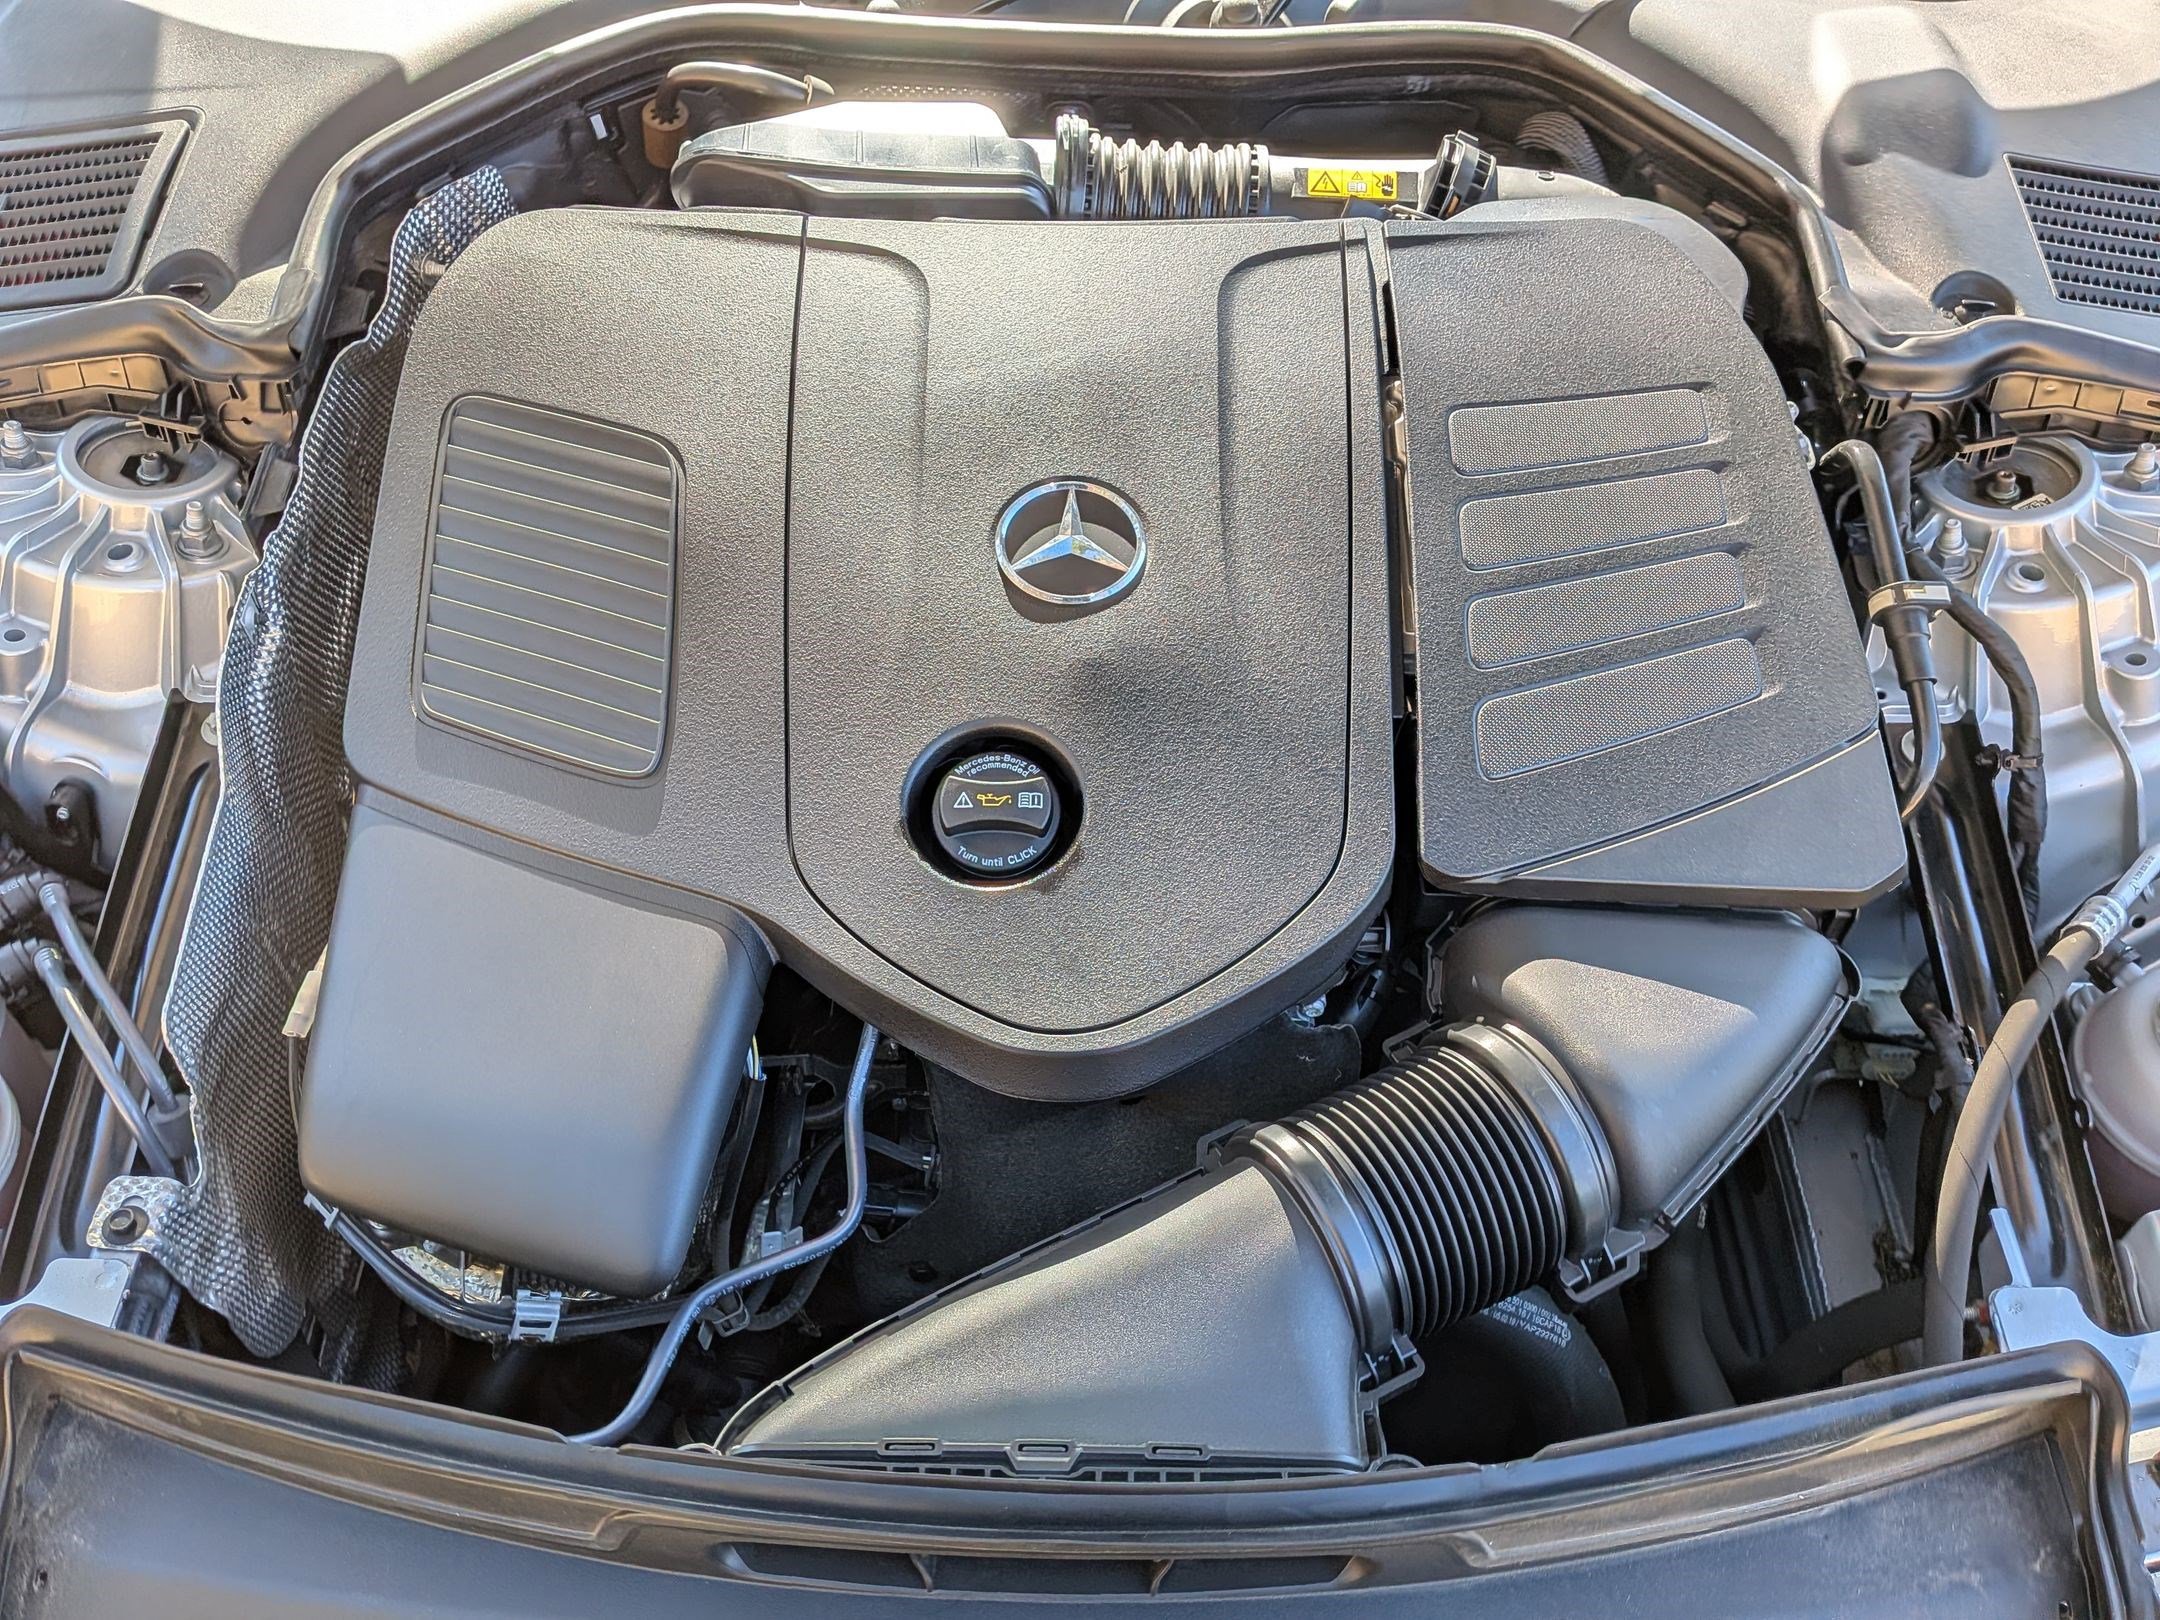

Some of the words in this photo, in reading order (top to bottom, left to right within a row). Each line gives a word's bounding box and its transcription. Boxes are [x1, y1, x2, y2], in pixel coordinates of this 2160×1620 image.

[954, 754, 1027, 776] Mercedes-Benz
[1027, 764, 1041, 775] Oil
[966, 761, 1030, 778] recommended
[957, 845, 978, 863] Turn
[981, 857, 1003, 866] until
[1007, 845, 1037, 865] CLICK
